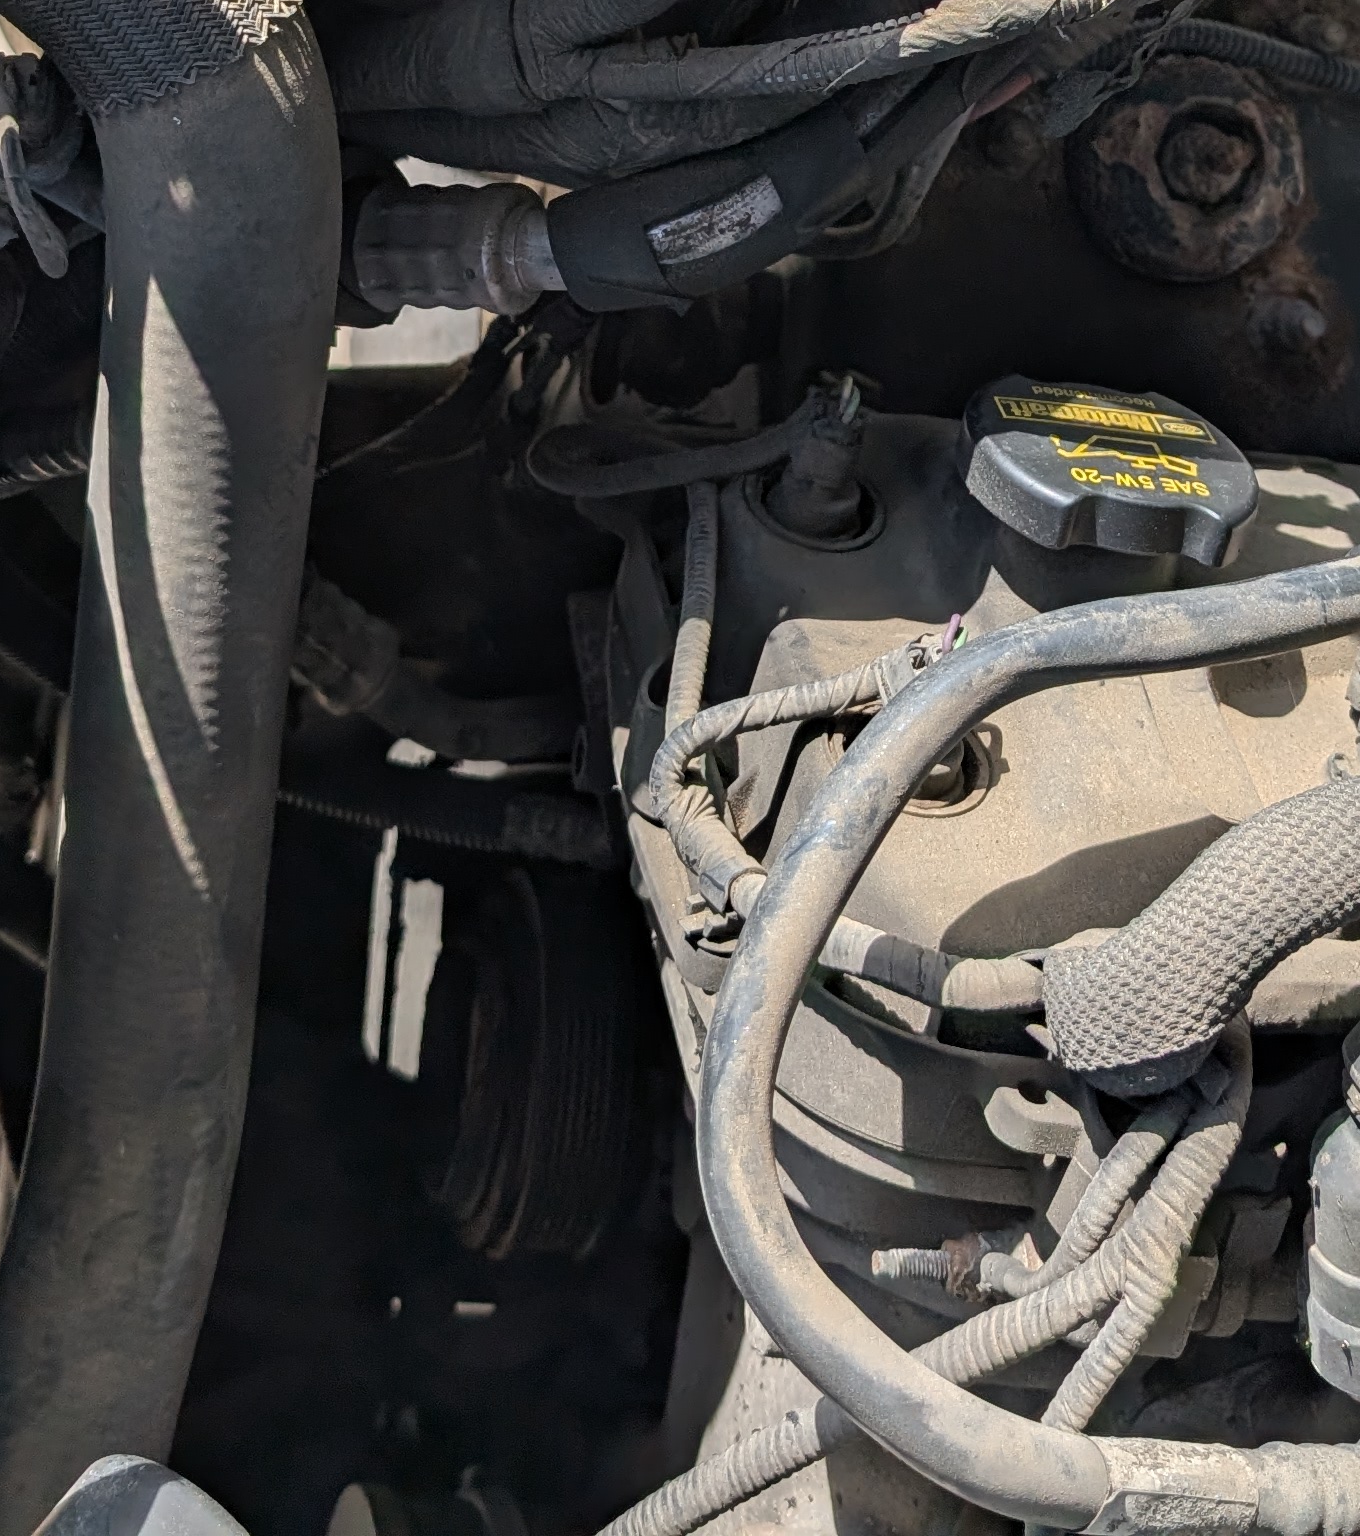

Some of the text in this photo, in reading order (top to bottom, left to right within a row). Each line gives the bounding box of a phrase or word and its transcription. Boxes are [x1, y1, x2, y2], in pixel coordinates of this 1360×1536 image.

[1031, 385, 1155, 409] Recommended
[1003, 400, 1154, 433] Motorcraft
[1070, 467, 1211, 498] SAE 5W-20
